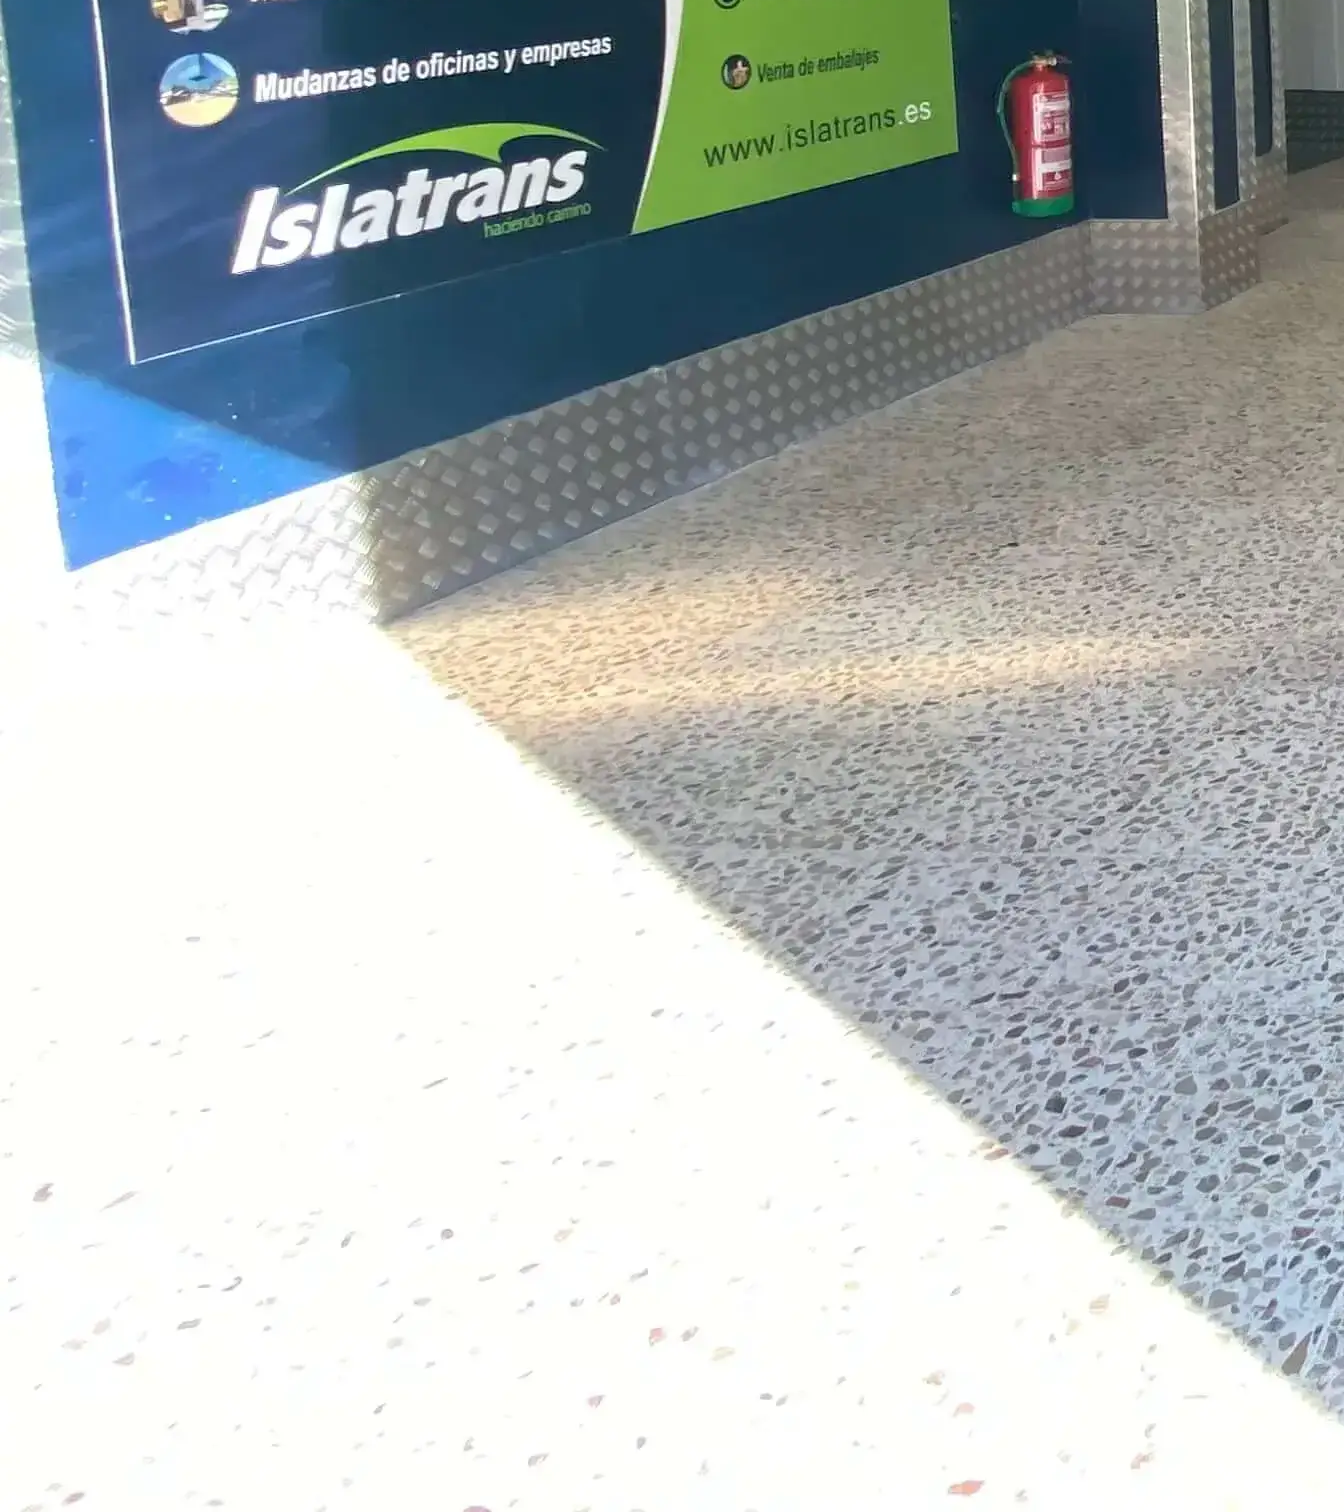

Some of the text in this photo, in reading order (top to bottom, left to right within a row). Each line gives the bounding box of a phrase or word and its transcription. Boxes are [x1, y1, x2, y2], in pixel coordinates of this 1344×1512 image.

[254, 35, 612, 102] Mudanzas de oficinas y empresas
[757, 48, 880, 83] Venta de embalajes
[704, 100, 932, 168] www.islatrans.es
[231, 150, 588, 275] Islatrans
[484, 203, 592, 238] haciendo camino
